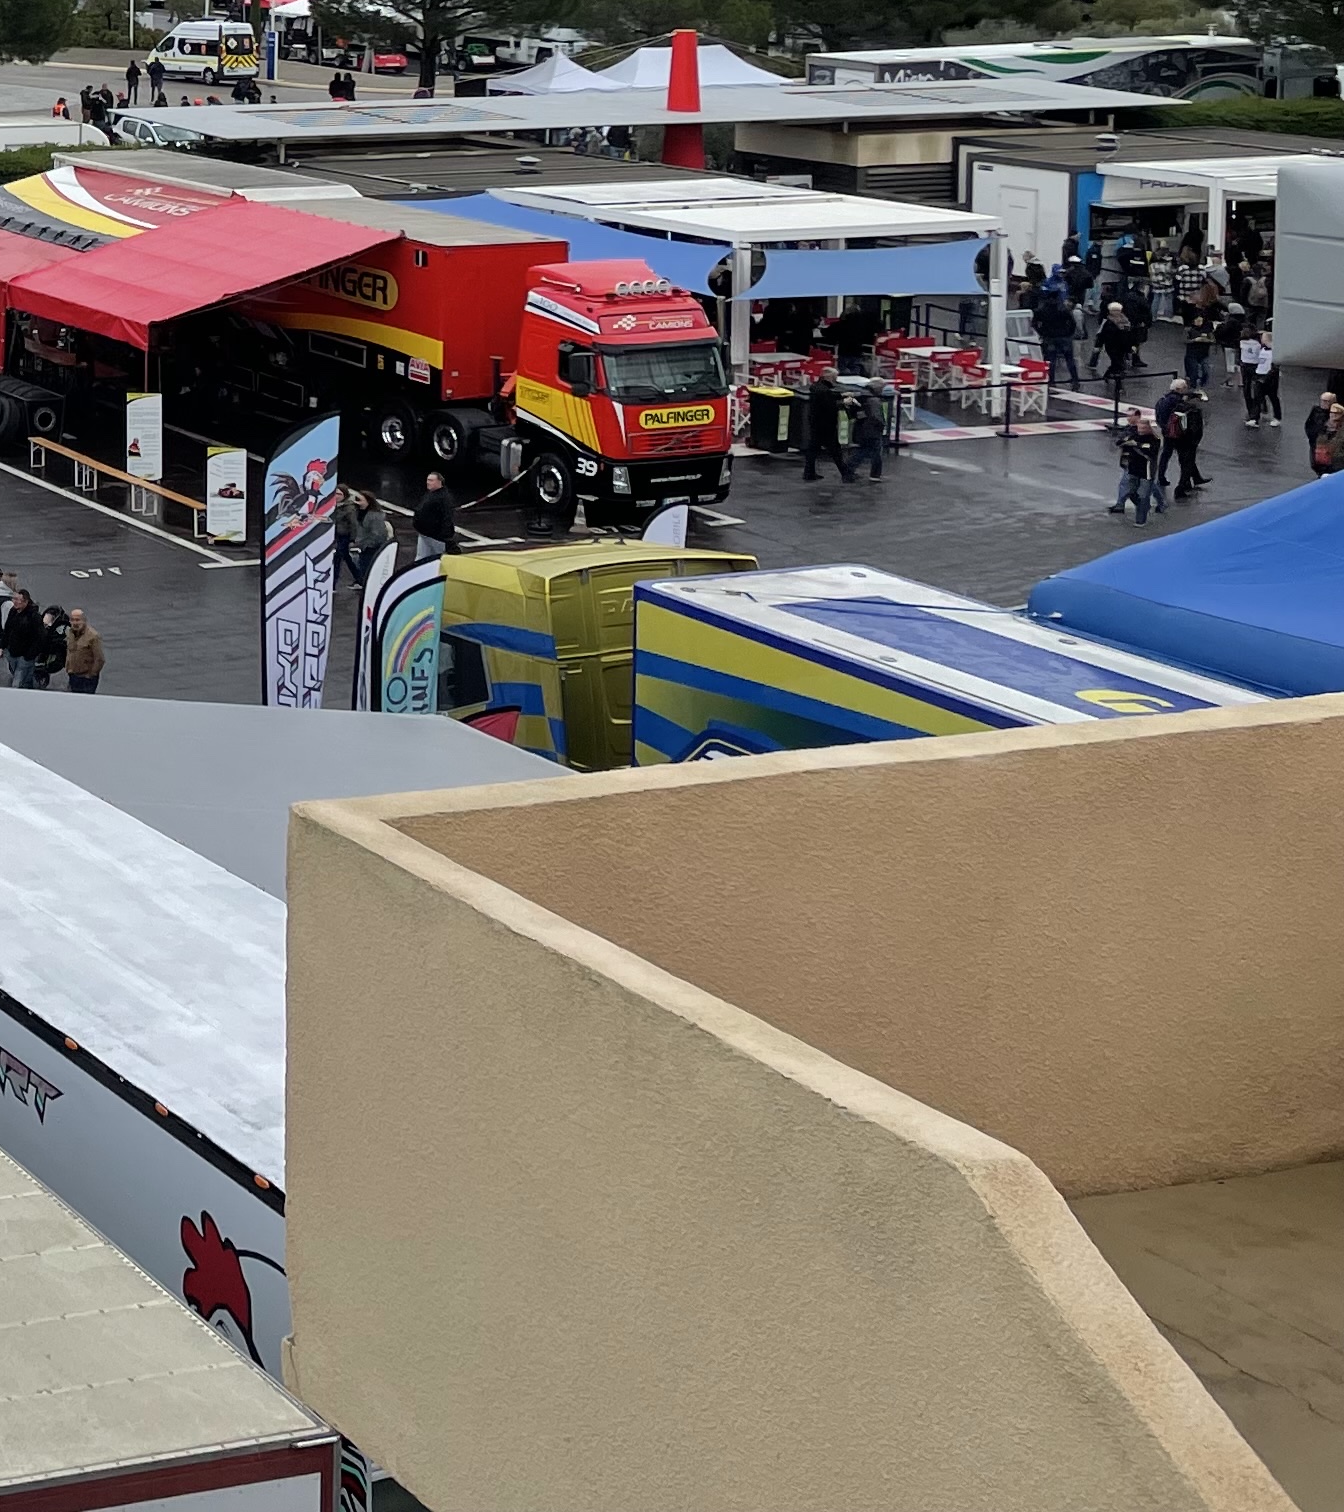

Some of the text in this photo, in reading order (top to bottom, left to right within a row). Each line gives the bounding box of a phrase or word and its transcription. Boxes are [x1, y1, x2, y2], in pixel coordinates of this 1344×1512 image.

[318, 266, 388, 306] INGER
[644, 409, 710, 426] PALFINGER
[575, 457, 598, 477] 39
